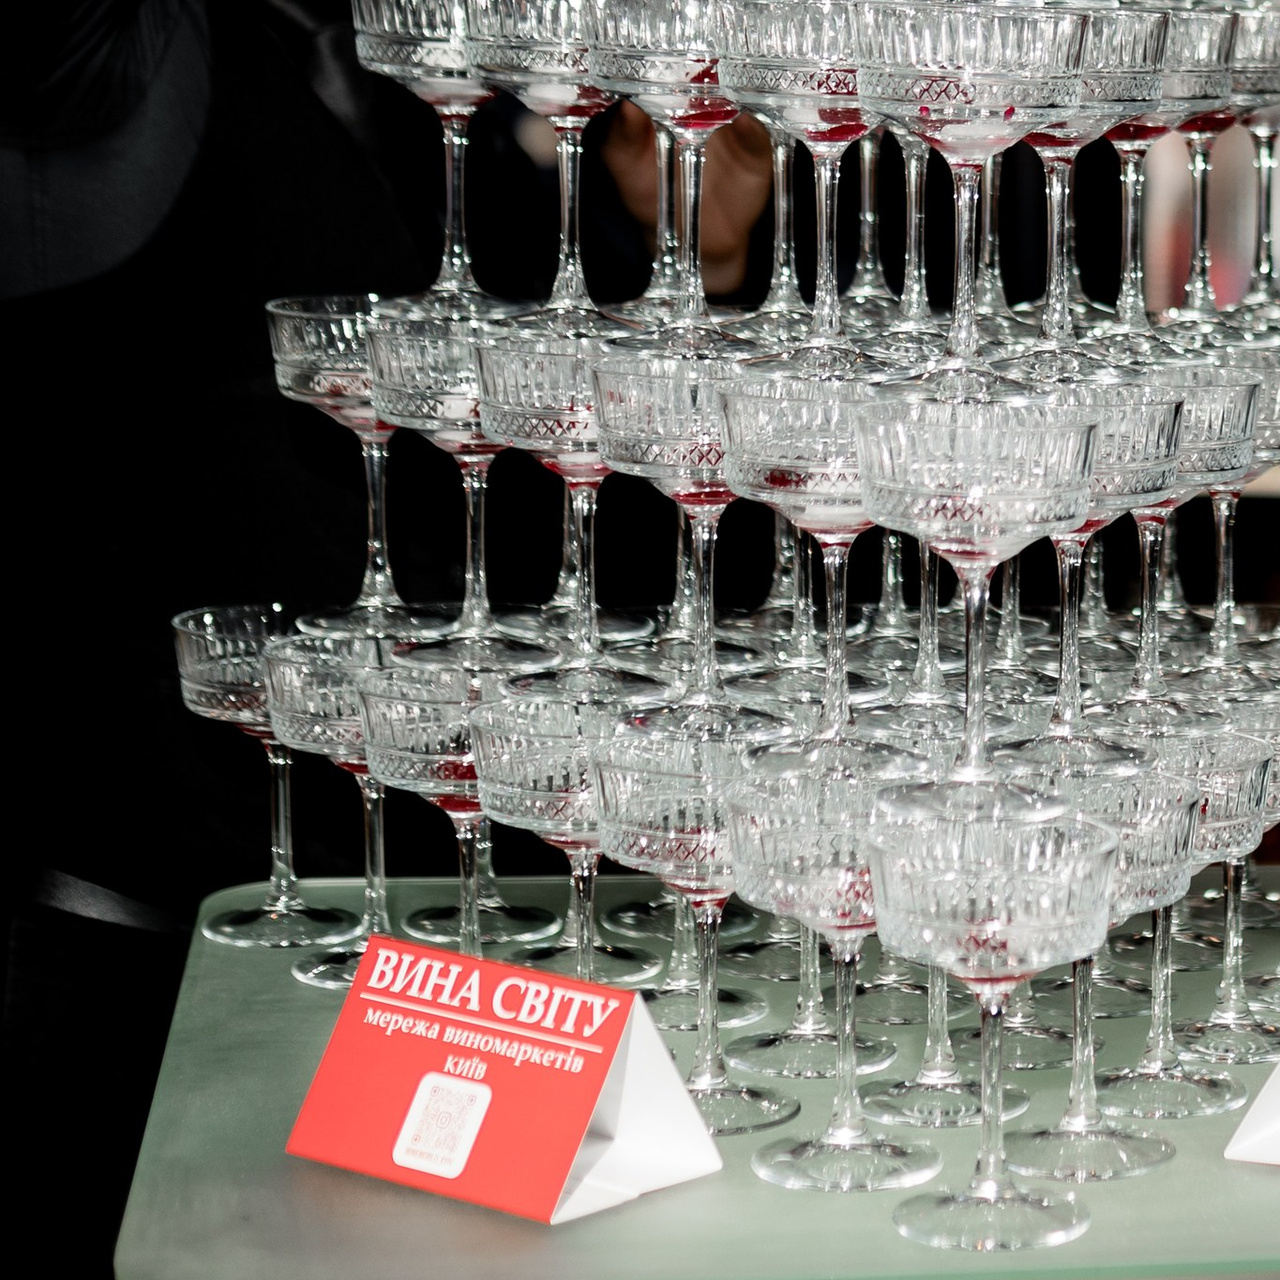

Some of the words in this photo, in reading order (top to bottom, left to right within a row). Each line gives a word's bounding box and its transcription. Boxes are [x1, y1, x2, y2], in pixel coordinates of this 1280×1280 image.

[367, 948, 480, 1011] ВИНА
[491, 976, 620, 1037] СВІТУ
[364, 1007, 438, 1039] мережа
[442, 1026, 584, 1073] виномаркетів
